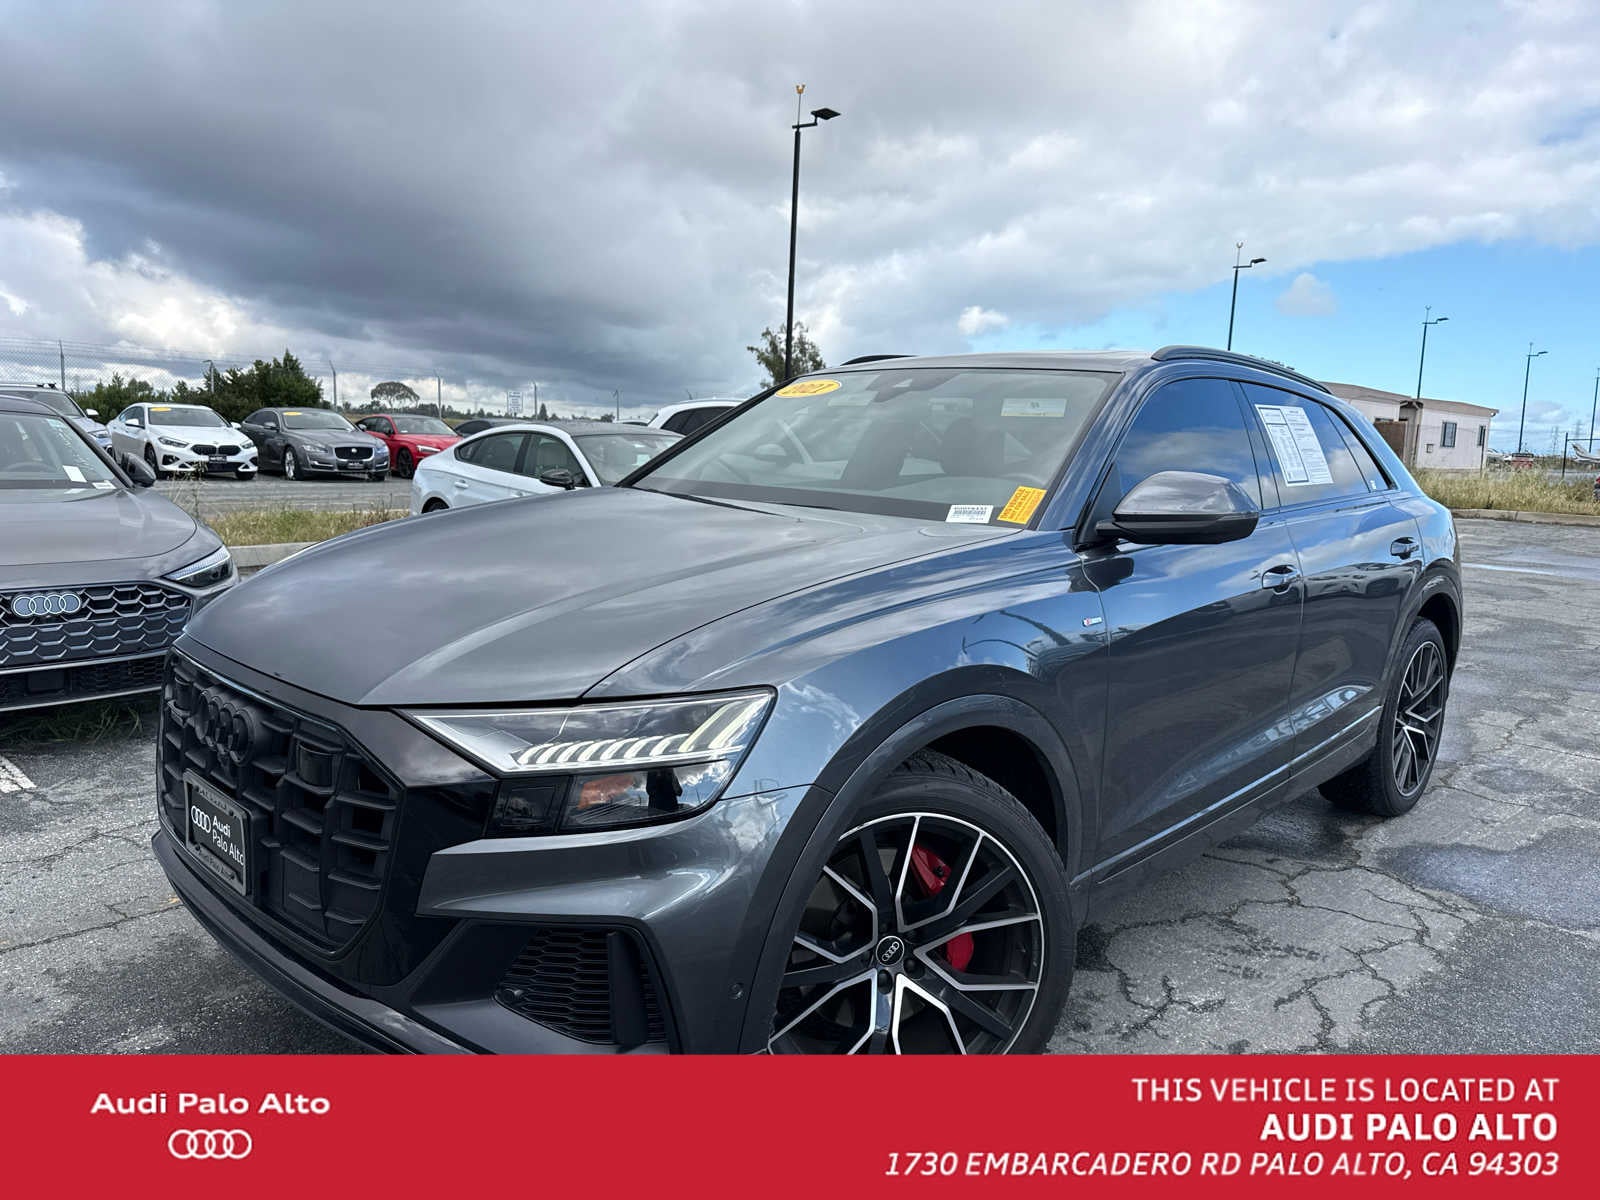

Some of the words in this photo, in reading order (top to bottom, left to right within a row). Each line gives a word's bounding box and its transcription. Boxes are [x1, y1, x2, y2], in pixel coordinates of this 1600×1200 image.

[212, 815, 231, 838] Audi
[212, 828, 228, 853] Palo
[228, 842, 245, 866] Alto
